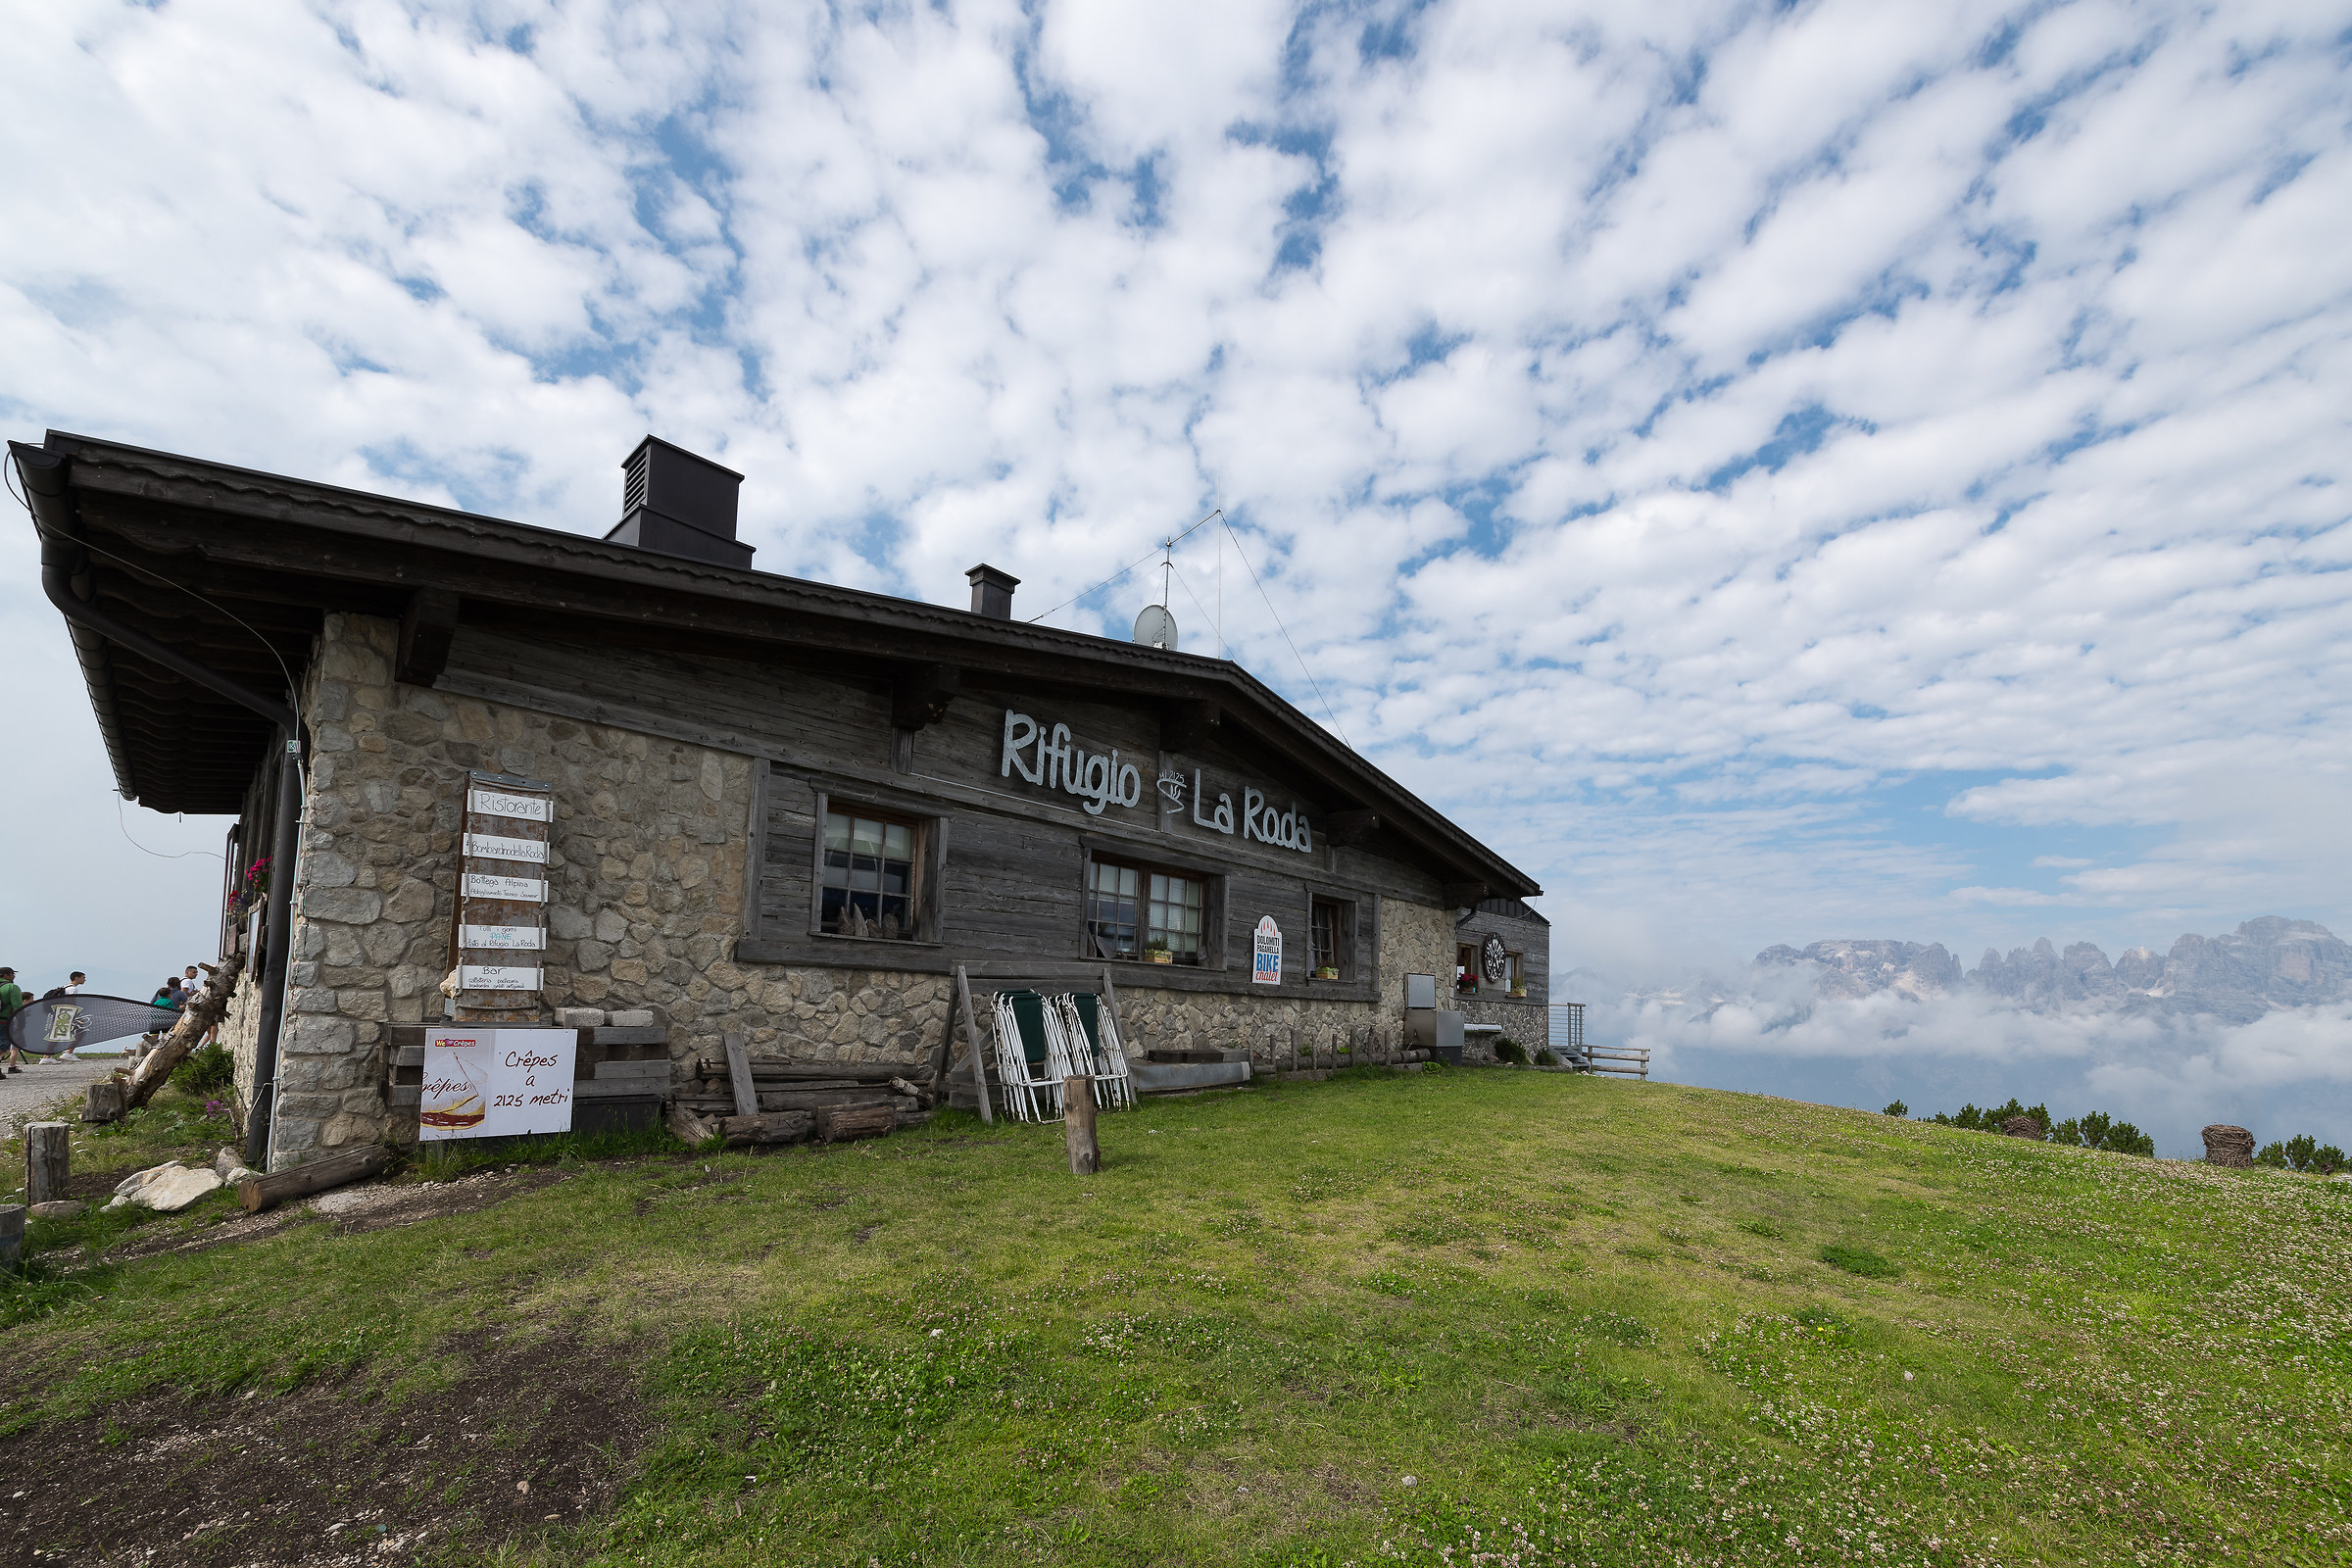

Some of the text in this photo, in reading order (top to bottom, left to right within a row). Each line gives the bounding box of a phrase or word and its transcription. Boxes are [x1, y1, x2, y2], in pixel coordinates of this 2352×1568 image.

[1002, 709, 1312, 854] Rifugio La Roda
[479, 793, 541, 815] Ristorante
[470, 874, 528, 888] Bottega Alpina
[490, 932, 513, 941] PANE
[1257, 935, 1280, 947] DOLOMITI
[489, 939, 509, 949] Rifugio
[520, 939, 536, 948] Roda
[1256, 945, 1280, 955] PAGANELLA
[1256, 953, 1279, 972] BIKE
[482, 966, 508, 975] Bar
[1255, 968, 1278, 982] chalet
[505, 1050, 559, 1073] Crêpes
[525, 1075, 535, 1087] a
[493, 1088, 570, 1107] 2125 metri
